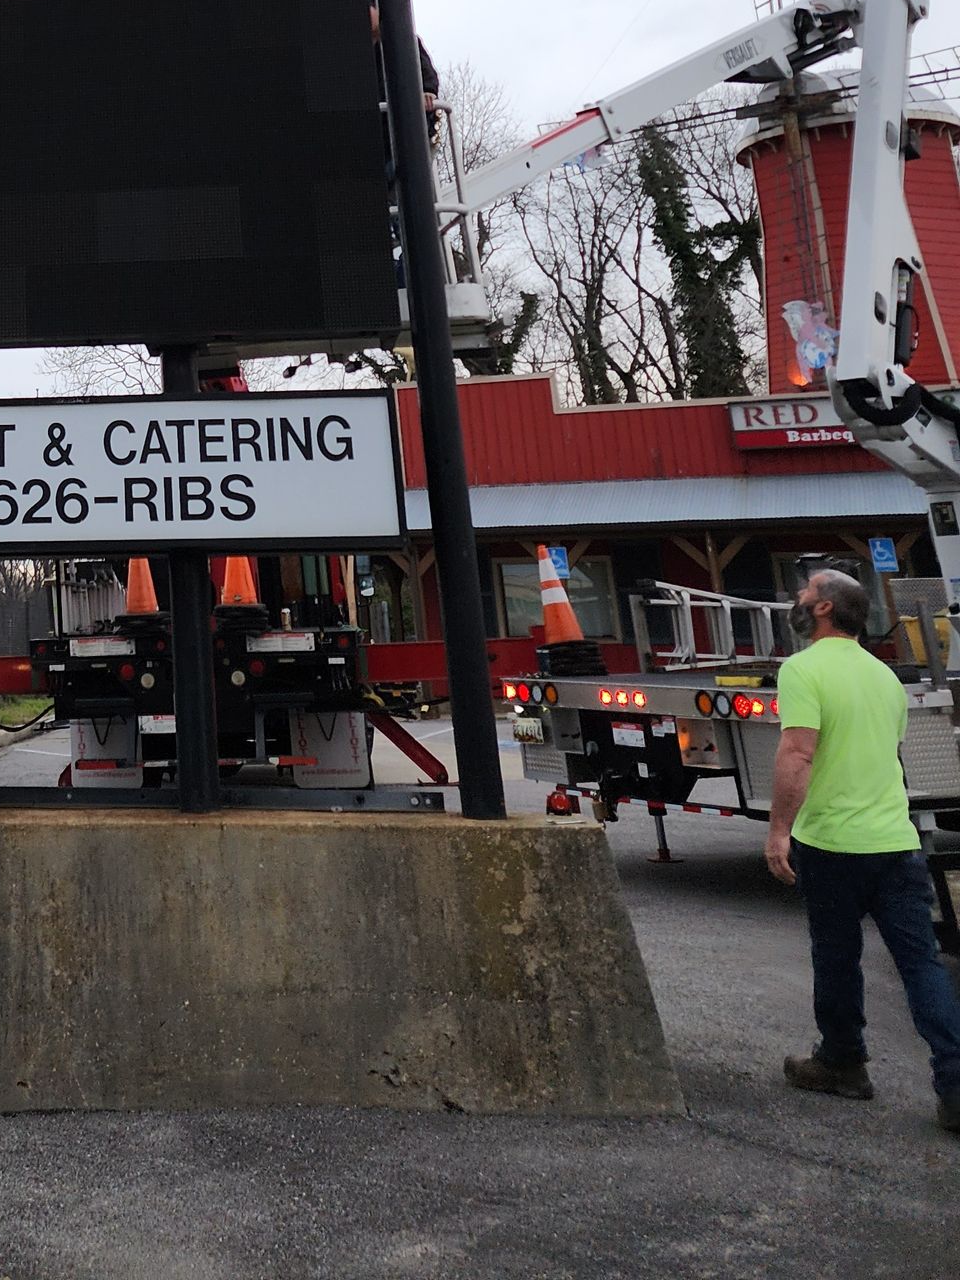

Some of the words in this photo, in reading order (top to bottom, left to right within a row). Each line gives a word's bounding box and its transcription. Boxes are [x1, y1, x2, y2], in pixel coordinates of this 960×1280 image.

[743, 404, 818, 427] RED
[42, 422, 74, 467] &
[103, 414, 355, 465] CATERING
